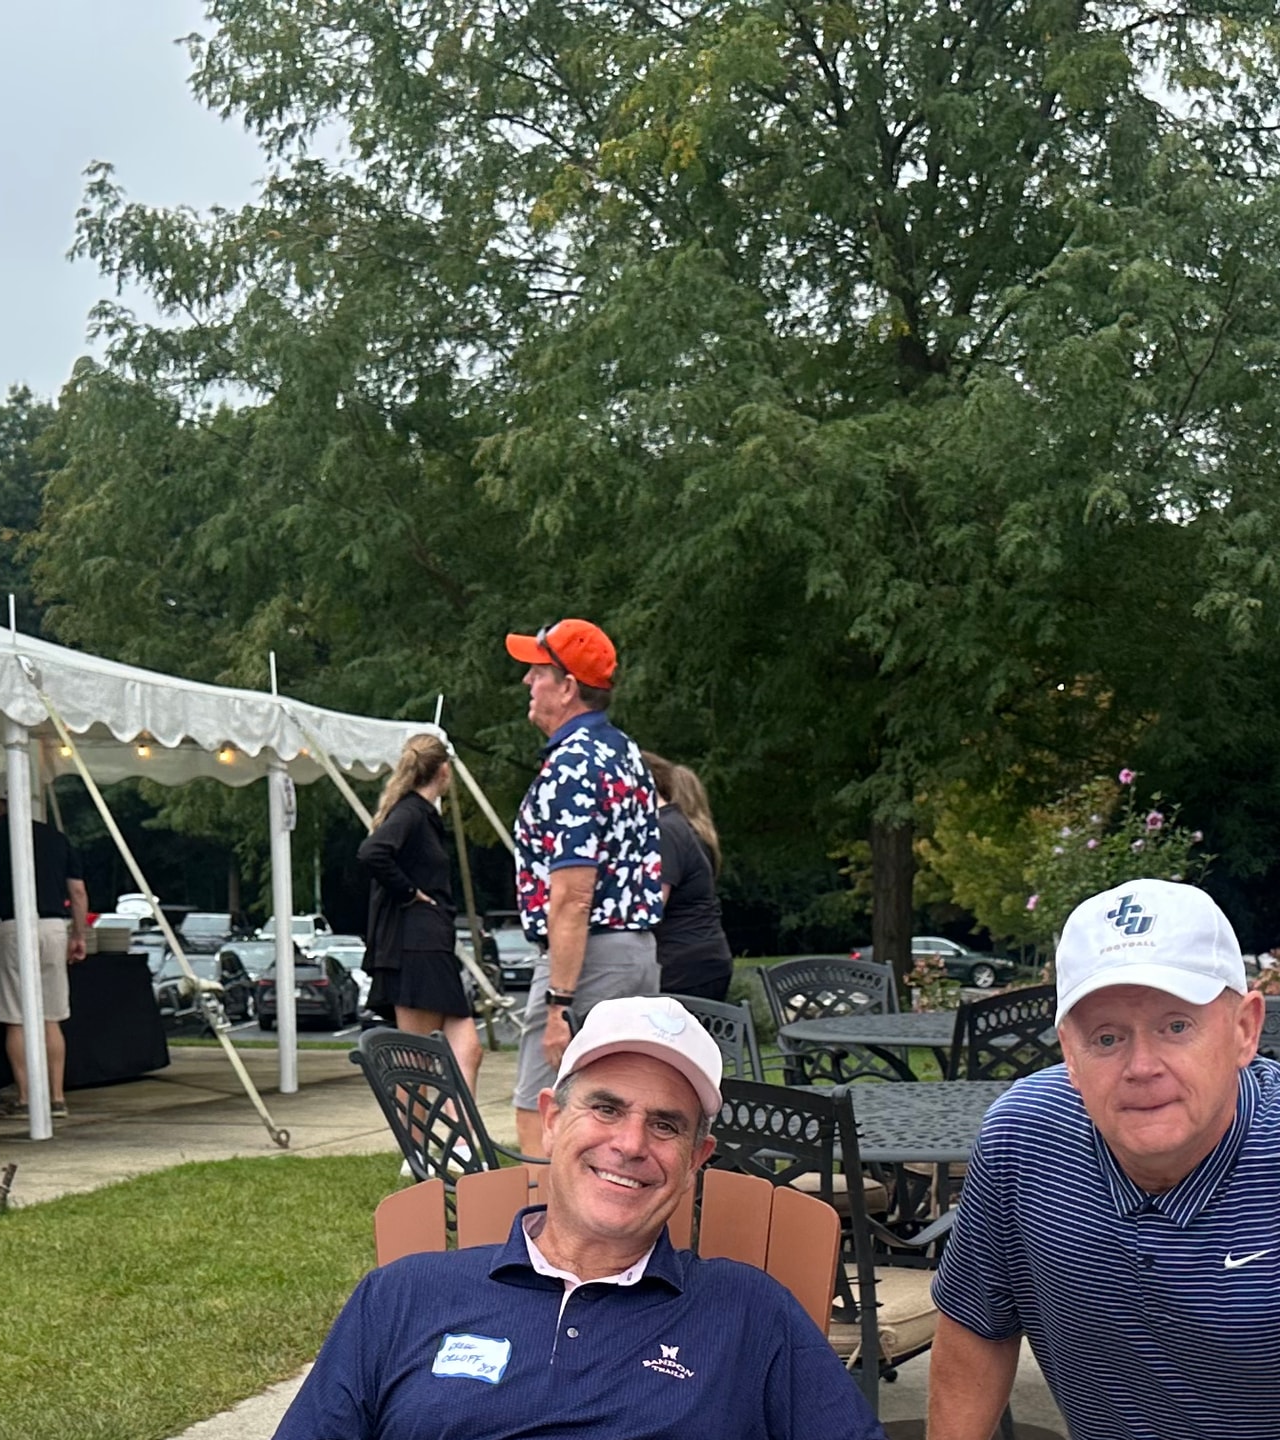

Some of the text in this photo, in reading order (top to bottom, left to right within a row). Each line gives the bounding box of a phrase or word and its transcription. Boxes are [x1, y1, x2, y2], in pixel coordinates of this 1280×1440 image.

[1106, 892, 1155, 936] JCU
[1099, 941, 1157, 955] FOOTBALL
[642, 1359, 695, 1378] BANDON
[651, 1365, 685, 1379] TRAILS
